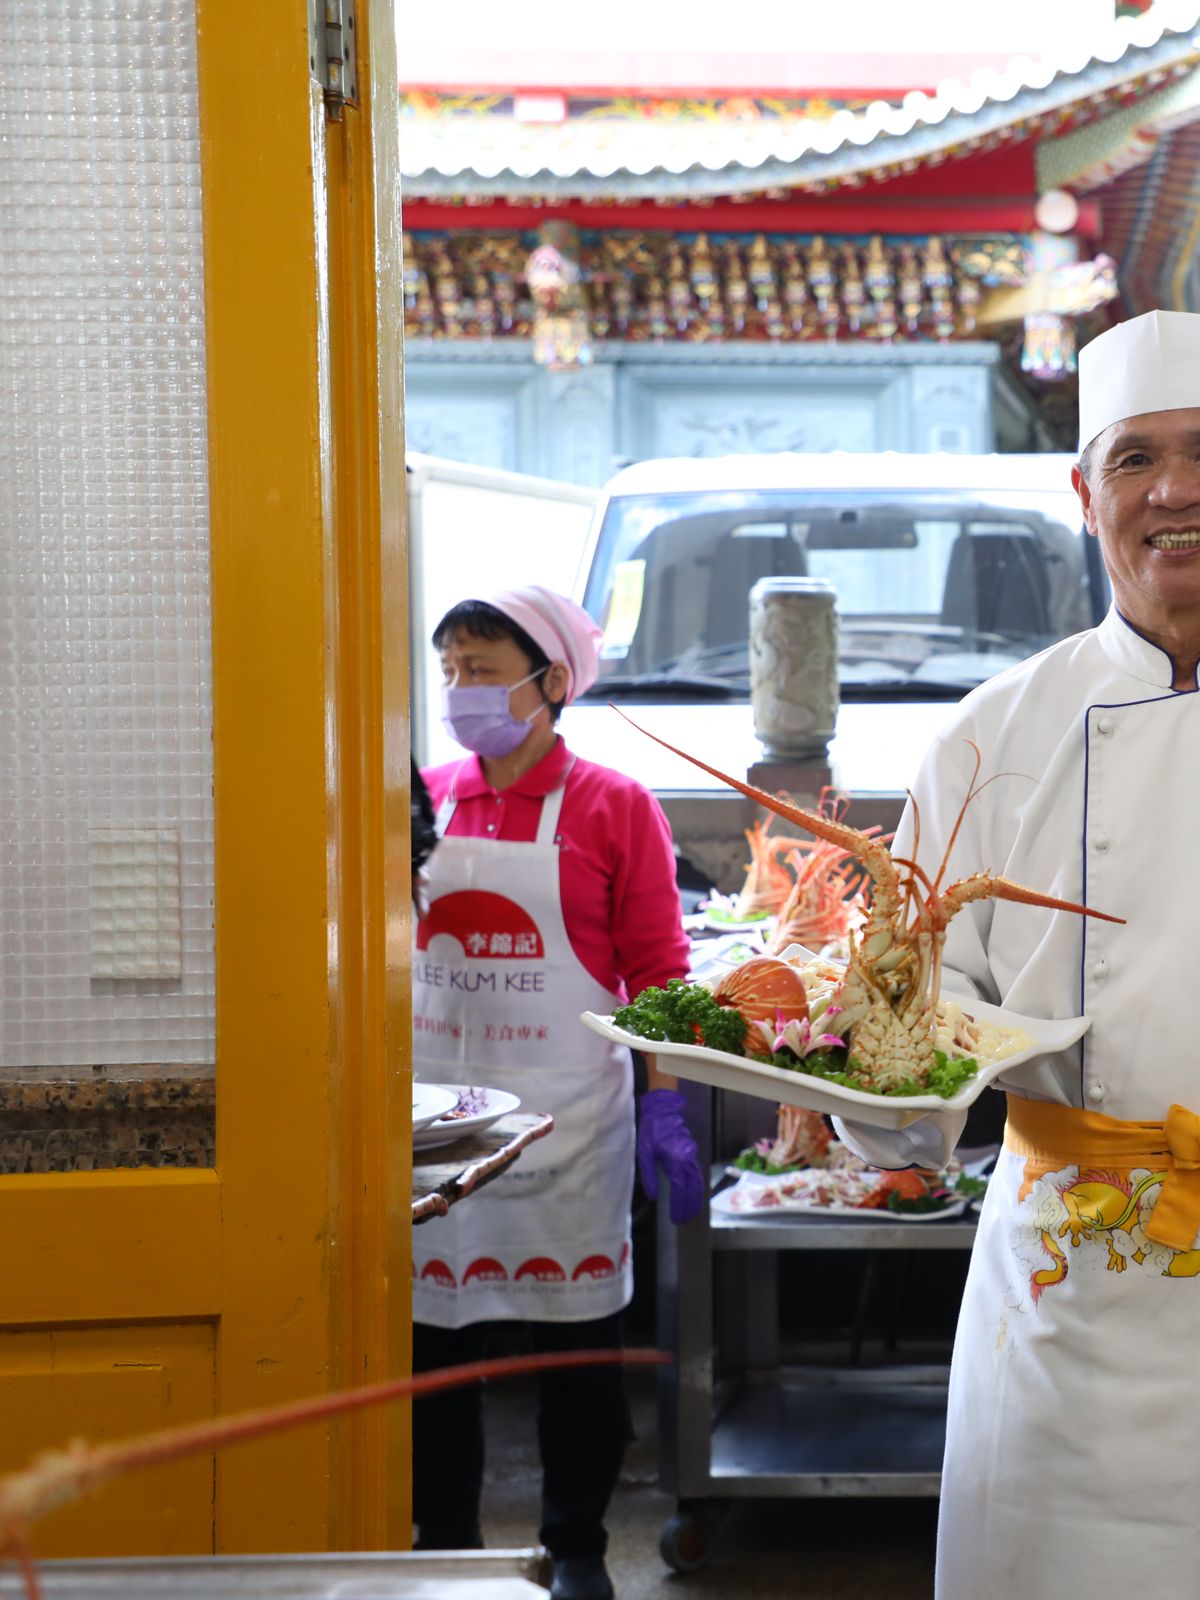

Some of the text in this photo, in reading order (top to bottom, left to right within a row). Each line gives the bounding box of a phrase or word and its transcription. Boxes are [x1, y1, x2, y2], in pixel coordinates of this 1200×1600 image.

[466, 932, 538, 955] 李錦記
[416, 963, 544, 993] LEE KUM KEE
